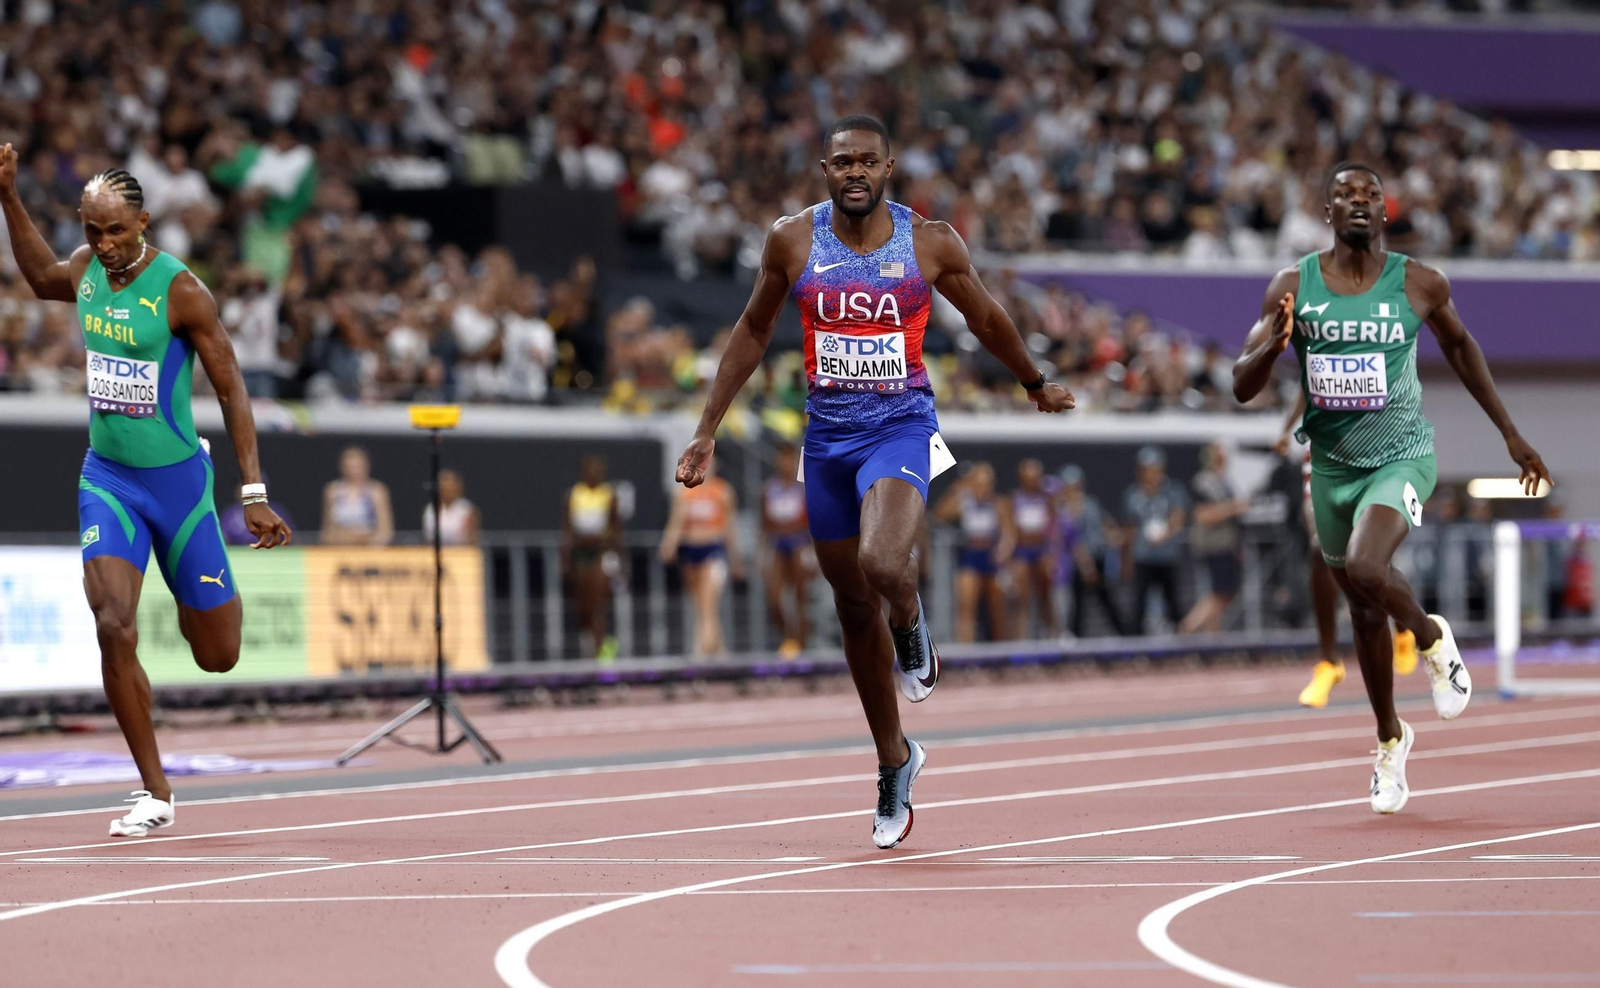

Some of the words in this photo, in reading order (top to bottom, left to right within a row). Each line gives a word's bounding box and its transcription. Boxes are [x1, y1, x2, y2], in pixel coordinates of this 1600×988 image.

[817, 292, 901, 326] USA
[85, 314, 137, 345] BRASIL
[1296, 319, 1406, 344] NIGERIA
[838, 336, 898, 355] TDK
[102, 357, 151, 380] TDK
[820, 356, 902, 377] BENJAMIN
[1325, 356, 1378, 373] TDK
[91, 377, 111, 397] DOS
[112, 381, 154, 401] SANTOS
[1310, 377, 1383, 394] NATHANIEL
